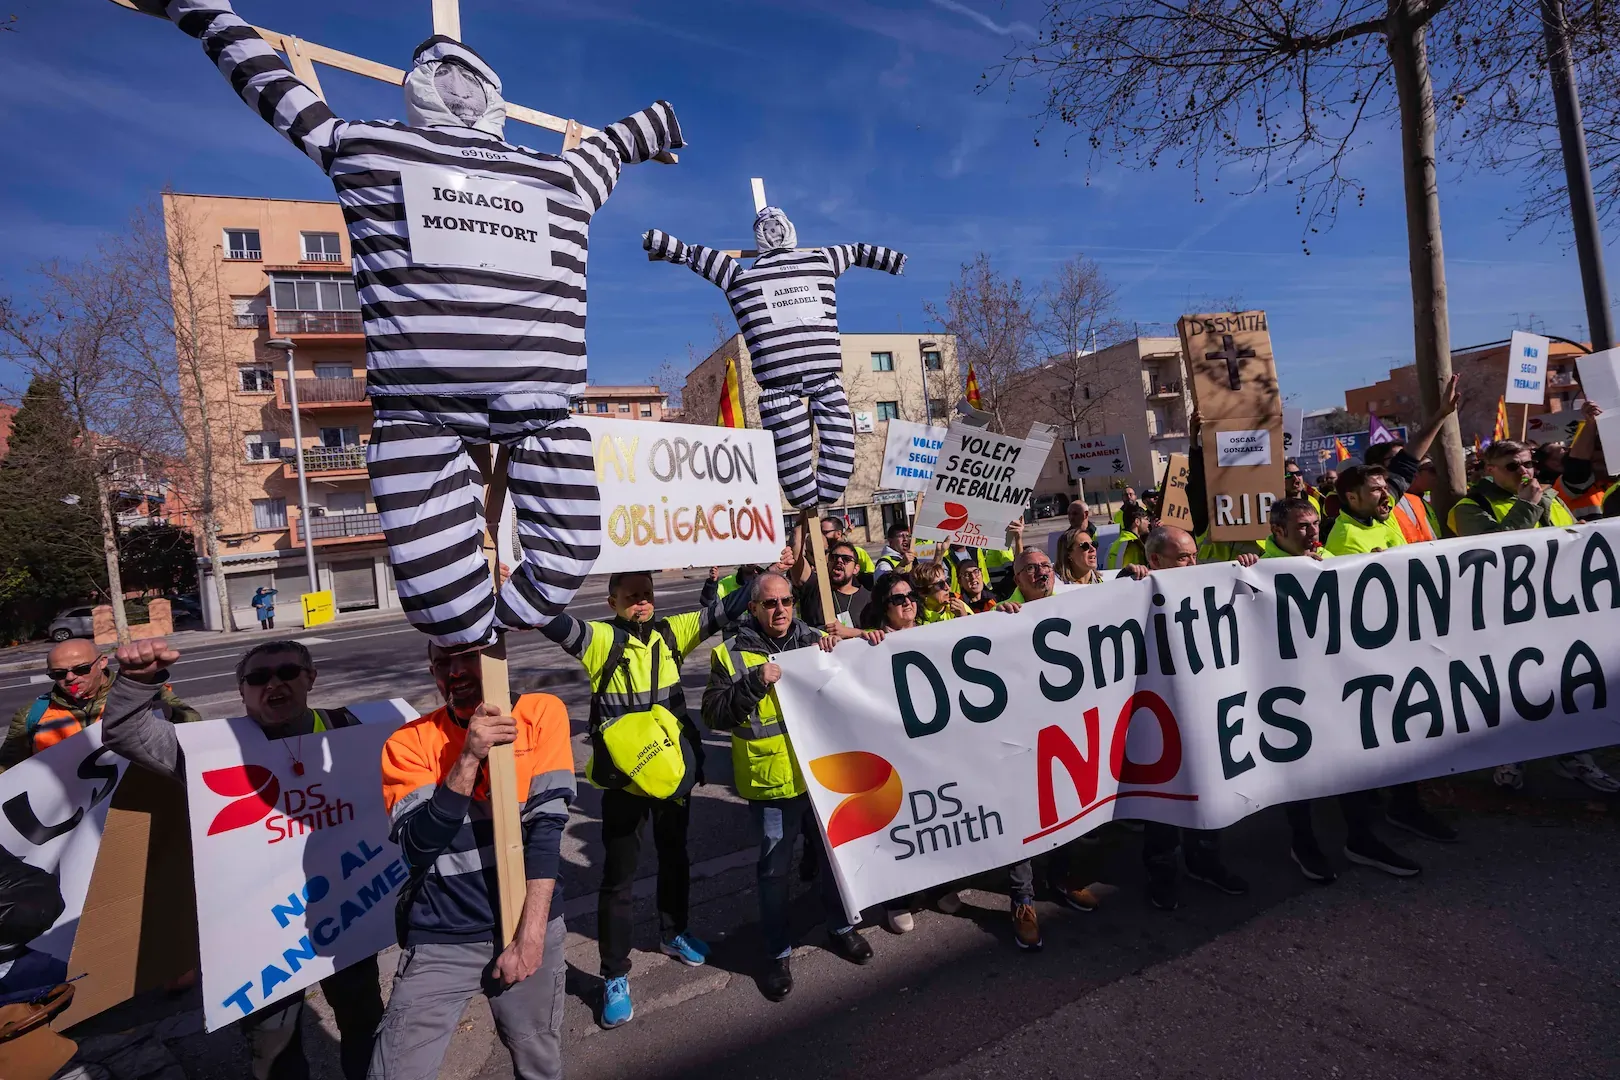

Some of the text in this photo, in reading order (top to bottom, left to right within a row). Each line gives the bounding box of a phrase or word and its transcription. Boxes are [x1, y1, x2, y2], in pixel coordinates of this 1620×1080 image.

[461, 149, 508, 160] 691691
[432, 187, 524, 213] IGNACIO
[422, 215, 538, 243] MONTFORT
[772, 297, 817, 308] FORCADELL
[774, 285, 809, 296] ALBERTO
[961, 435, 1021, 464] VOLEM
[1069, 448, 1120, 460] TANCAMENT
[1230, 436, 1256, 444] OSCAR
[593, 434, 758, 485] AY OPCIÓN
[909, 452, 938, 465] SEGUI
[946, 455, 1016, 483] SEGUIR
[936, 474, 1033, 507] TREBALLANT
[953, 531, 988, 547] Smith
[964, 522, 982, 535] DS
[891, 531, 1620, 739] DS Smith MONTBLA
[1036, 639, 1607, 829] NO ES TANCA
[284, 783, 326, 815] DS
[909, 782, 963, 825] DS
[265, 798, 354, 844] Smith
[889, 805, 1004, 861] Smith
[271, 840, 383, 928] NO AL
